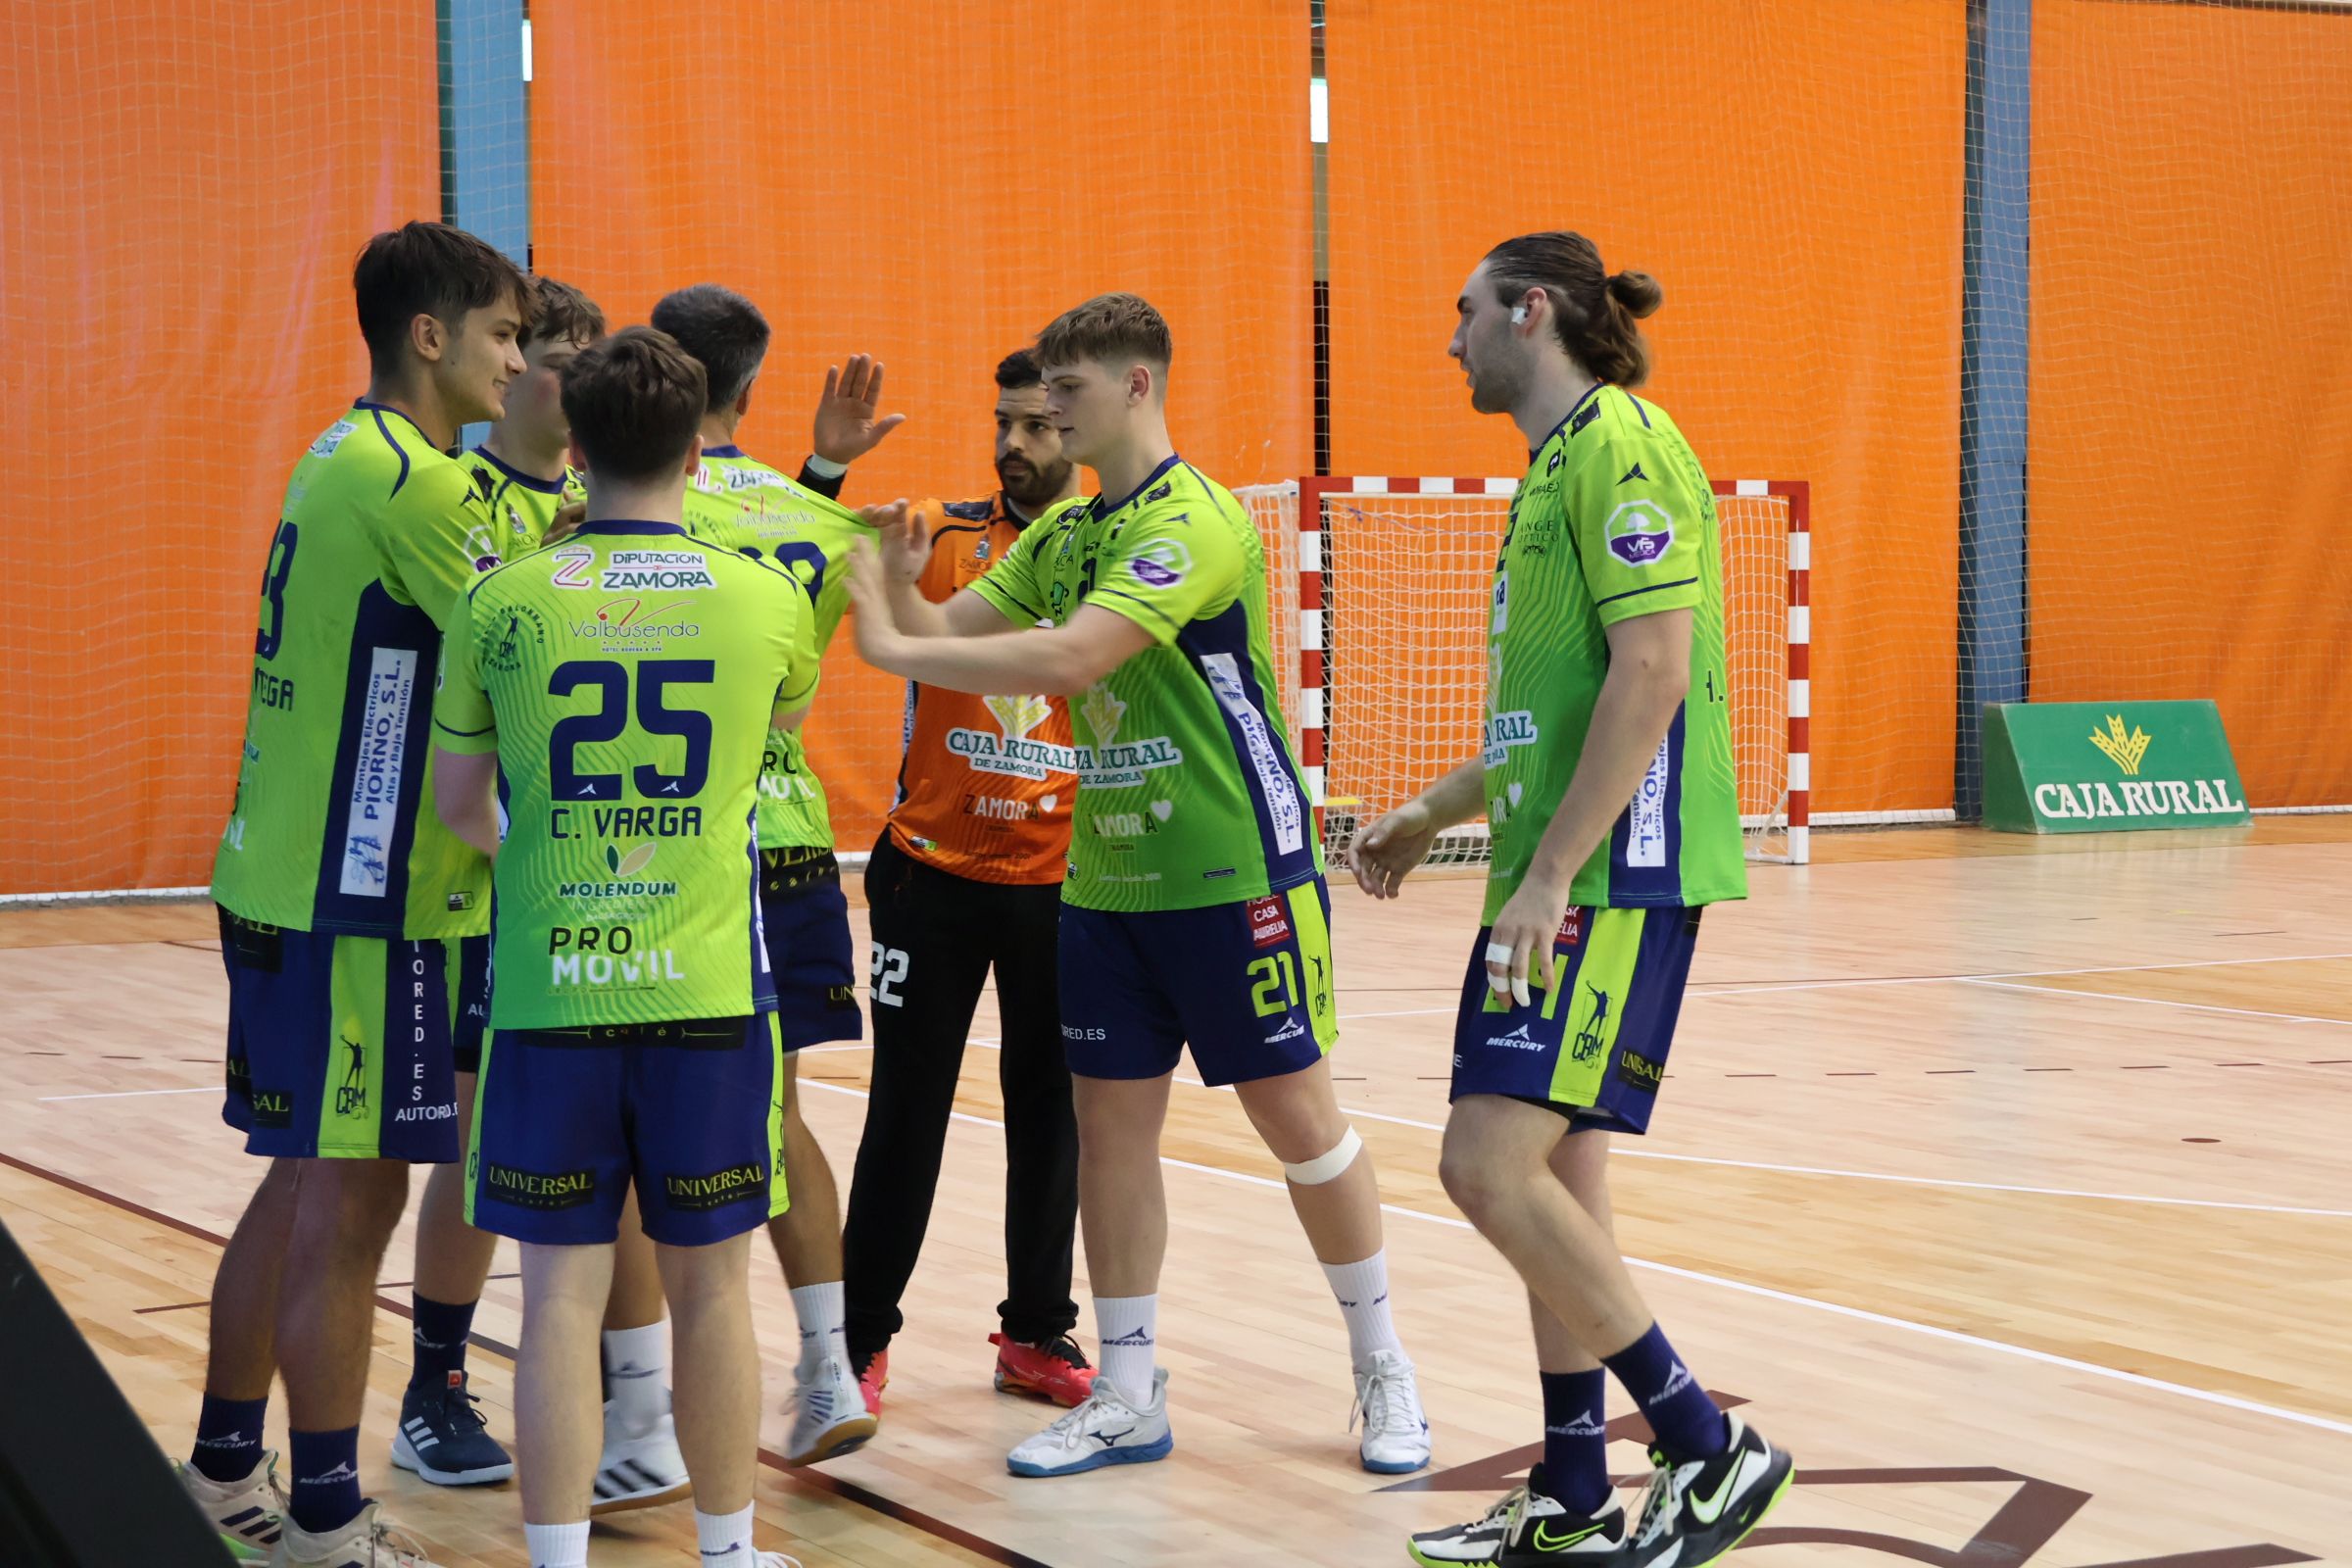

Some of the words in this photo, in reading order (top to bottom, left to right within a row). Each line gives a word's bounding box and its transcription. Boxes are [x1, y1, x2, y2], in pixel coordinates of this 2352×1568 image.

[604, 571, 713, 589] ZAMORA
[568, 619, 700, 638] Valbusenda
[395, 679, 411, 728] Tensión
[354, 741, 370, 803] Montajes
[364, 673, 381, 738] Eléctricos
[364, 711, 395, 820] PIORNO,
[381, 660, 402, 705] S.L.
[548, 659, 715, 802] 25
[391, 732, 404, 761] Baja
[949, 731, 996, 755] CAJA
[1004, 739, 1075, 770] RURAL
[1101, 742, 1177, 769] RURAL
[974, 758, 991, 767] DE
[994, 761, 1043, 777] ZAMORA
[1094, 771, 1143, 784] ZAMORA
[963, 794, 1040, 820] ZAMORA
[2034, 782, 2124, 819] CAJA
[2118, 779, 2244, 816] RURAL
[551, 808, 581, 839] C.
[594, 807, 703, 838] VARGA
[560, 882, 676, 897] MOLENDUM
[1253, 905, 1280, 922] CASA
[549, 925, 632, 956] PRO
[1253, 919, 1289, 941] AURELIA
[1247, 951, 1299, 1018] 21
[1487, 1038, 1546, 1052] MERCURY
[490, 1165, 593, 1196] UNIVERSAL
[667, 1164, 764, 1196] UNIVERSAL
